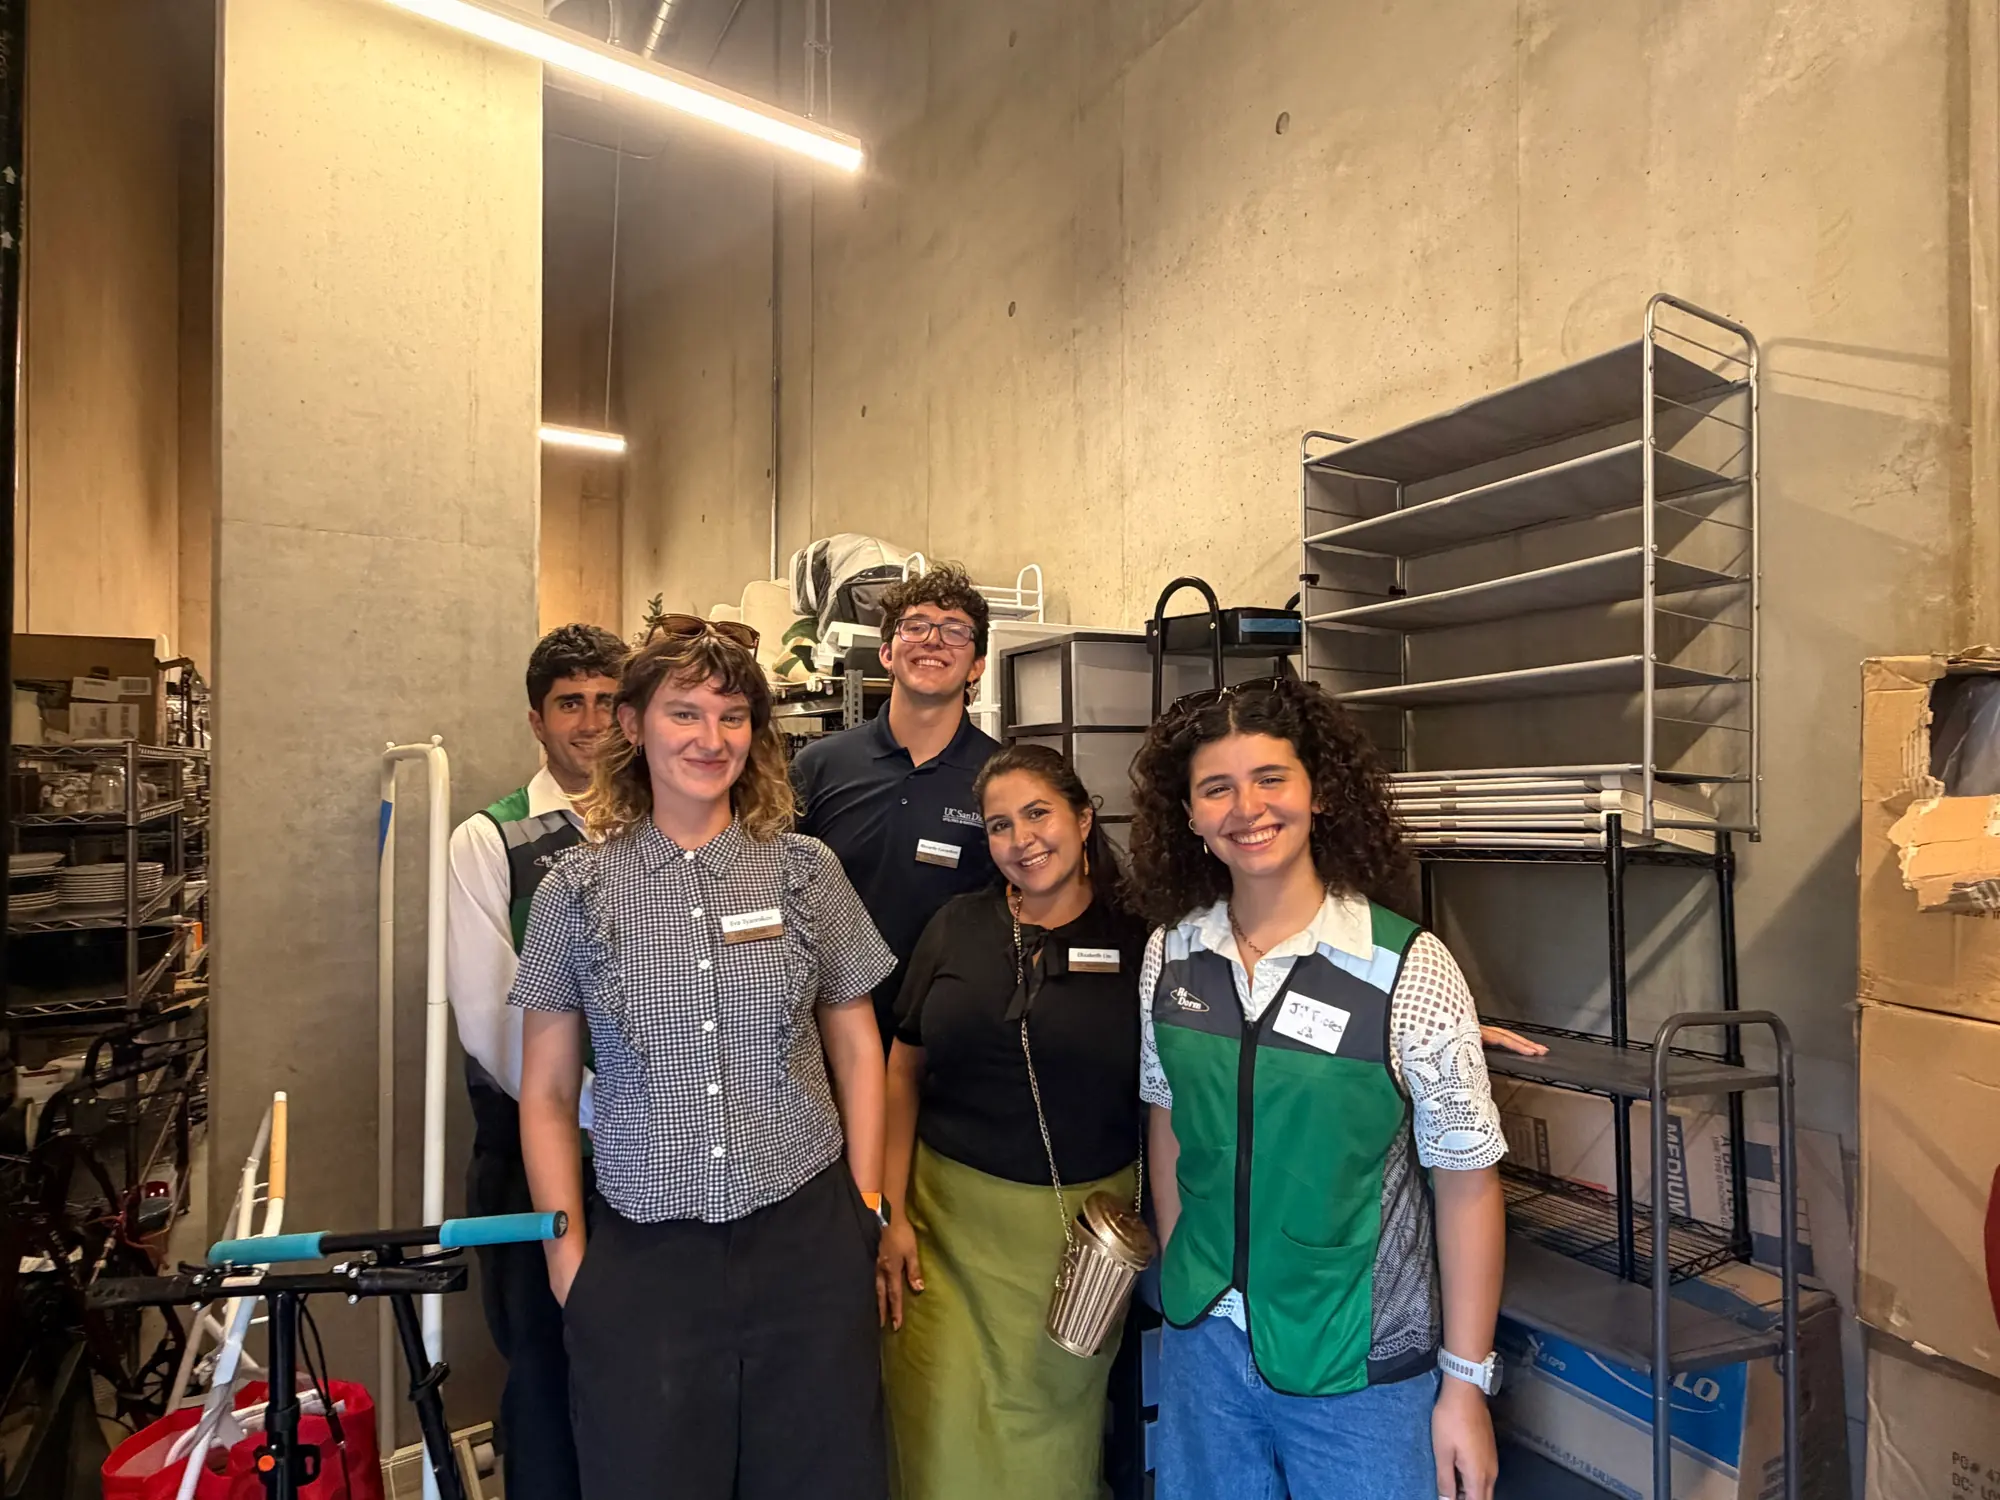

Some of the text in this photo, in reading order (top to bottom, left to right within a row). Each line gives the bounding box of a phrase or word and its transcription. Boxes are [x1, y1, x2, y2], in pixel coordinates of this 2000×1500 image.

[944, 807, 957, 816] UC
[957, 809, 971, 820] San
[1177, 996, 1202, 1010] Dorm
[1667, 1123, 1686, 1218] MEDIUM
